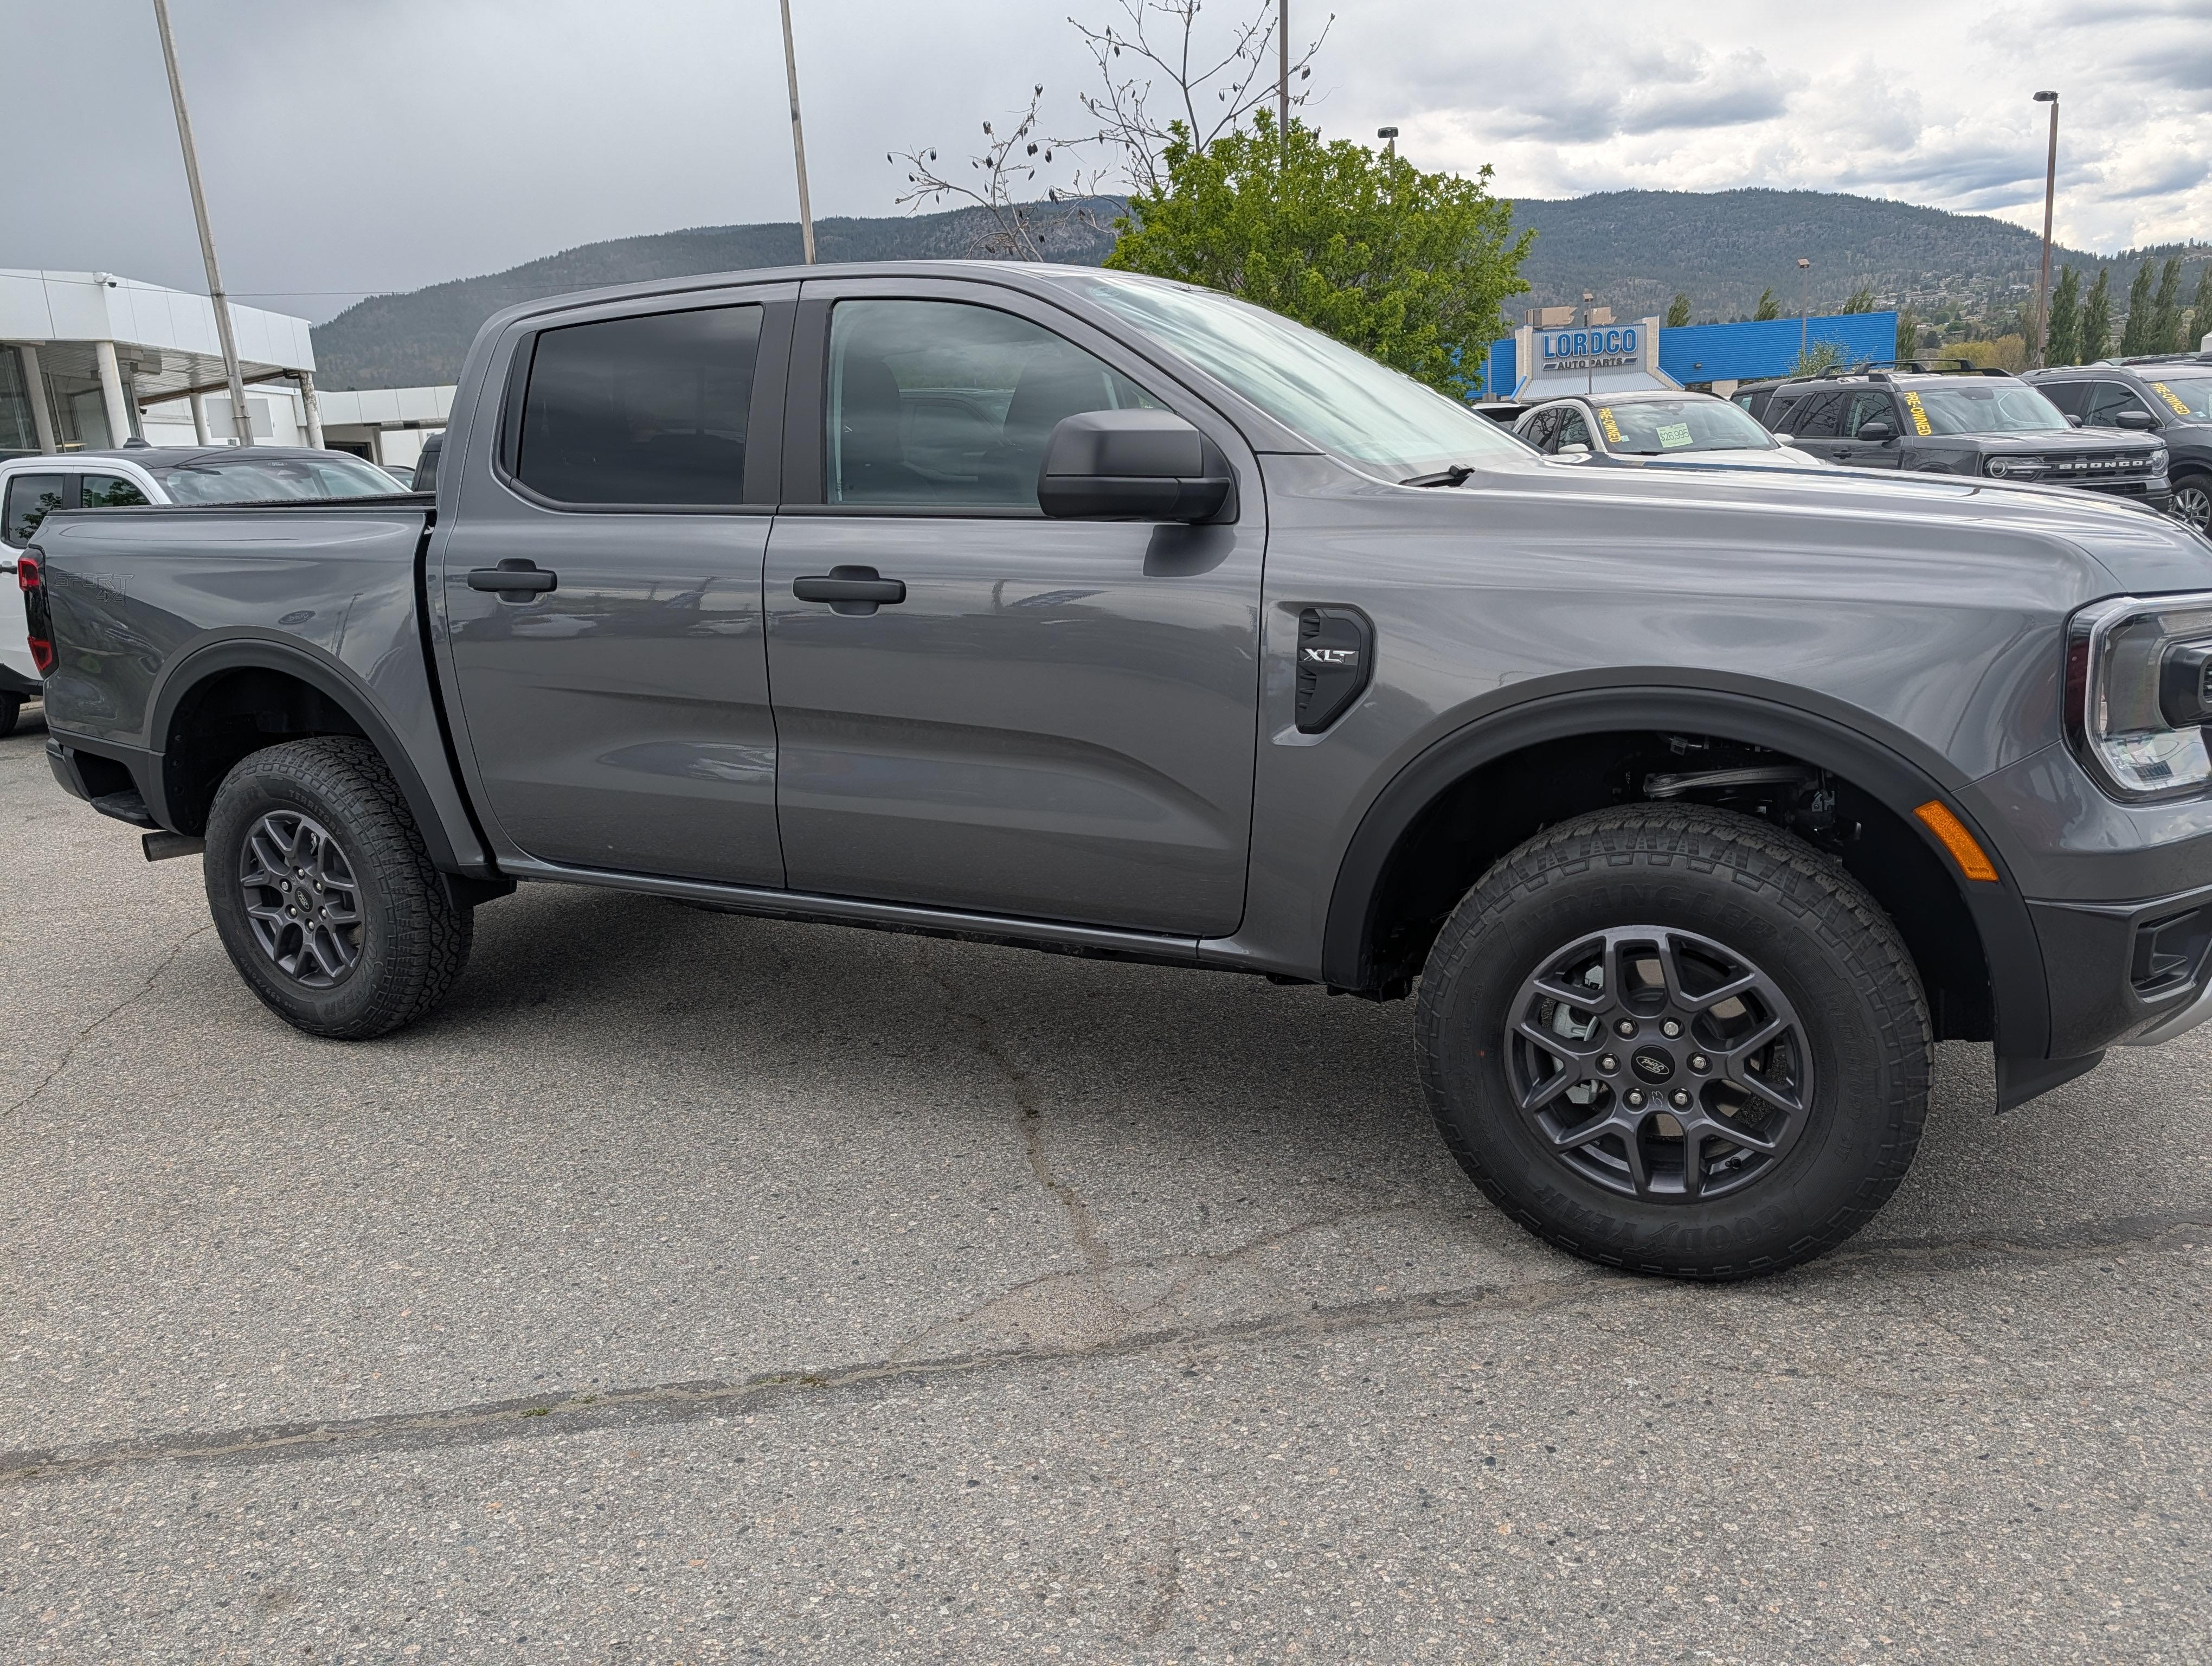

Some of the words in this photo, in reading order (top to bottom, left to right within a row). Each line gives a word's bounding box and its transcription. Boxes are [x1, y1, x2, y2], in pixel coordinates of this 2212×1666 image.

[1544, 329, 1637, 358] LORDCO
[1557, 360, 1586, 369] AUTO
[1591, 357, 1623, 368] PARTS
[2150, 382, 2190, 415] PRE-OWNED
[1597, 408, 1622, 443] PRE-OWNED
[1904, 392, 1931, 436] PRE-OWNED
[1660, 428, 1689, 441] $26,995
[2059, 460, 2143, 470] BRONCO
[55, 572, 134, 589] SPORT
[1303, 648, 1356, 663] XLT
[289, 789, 343, 836] TERRITORY
[1515, 883, 1779, 942] WRANGLER
